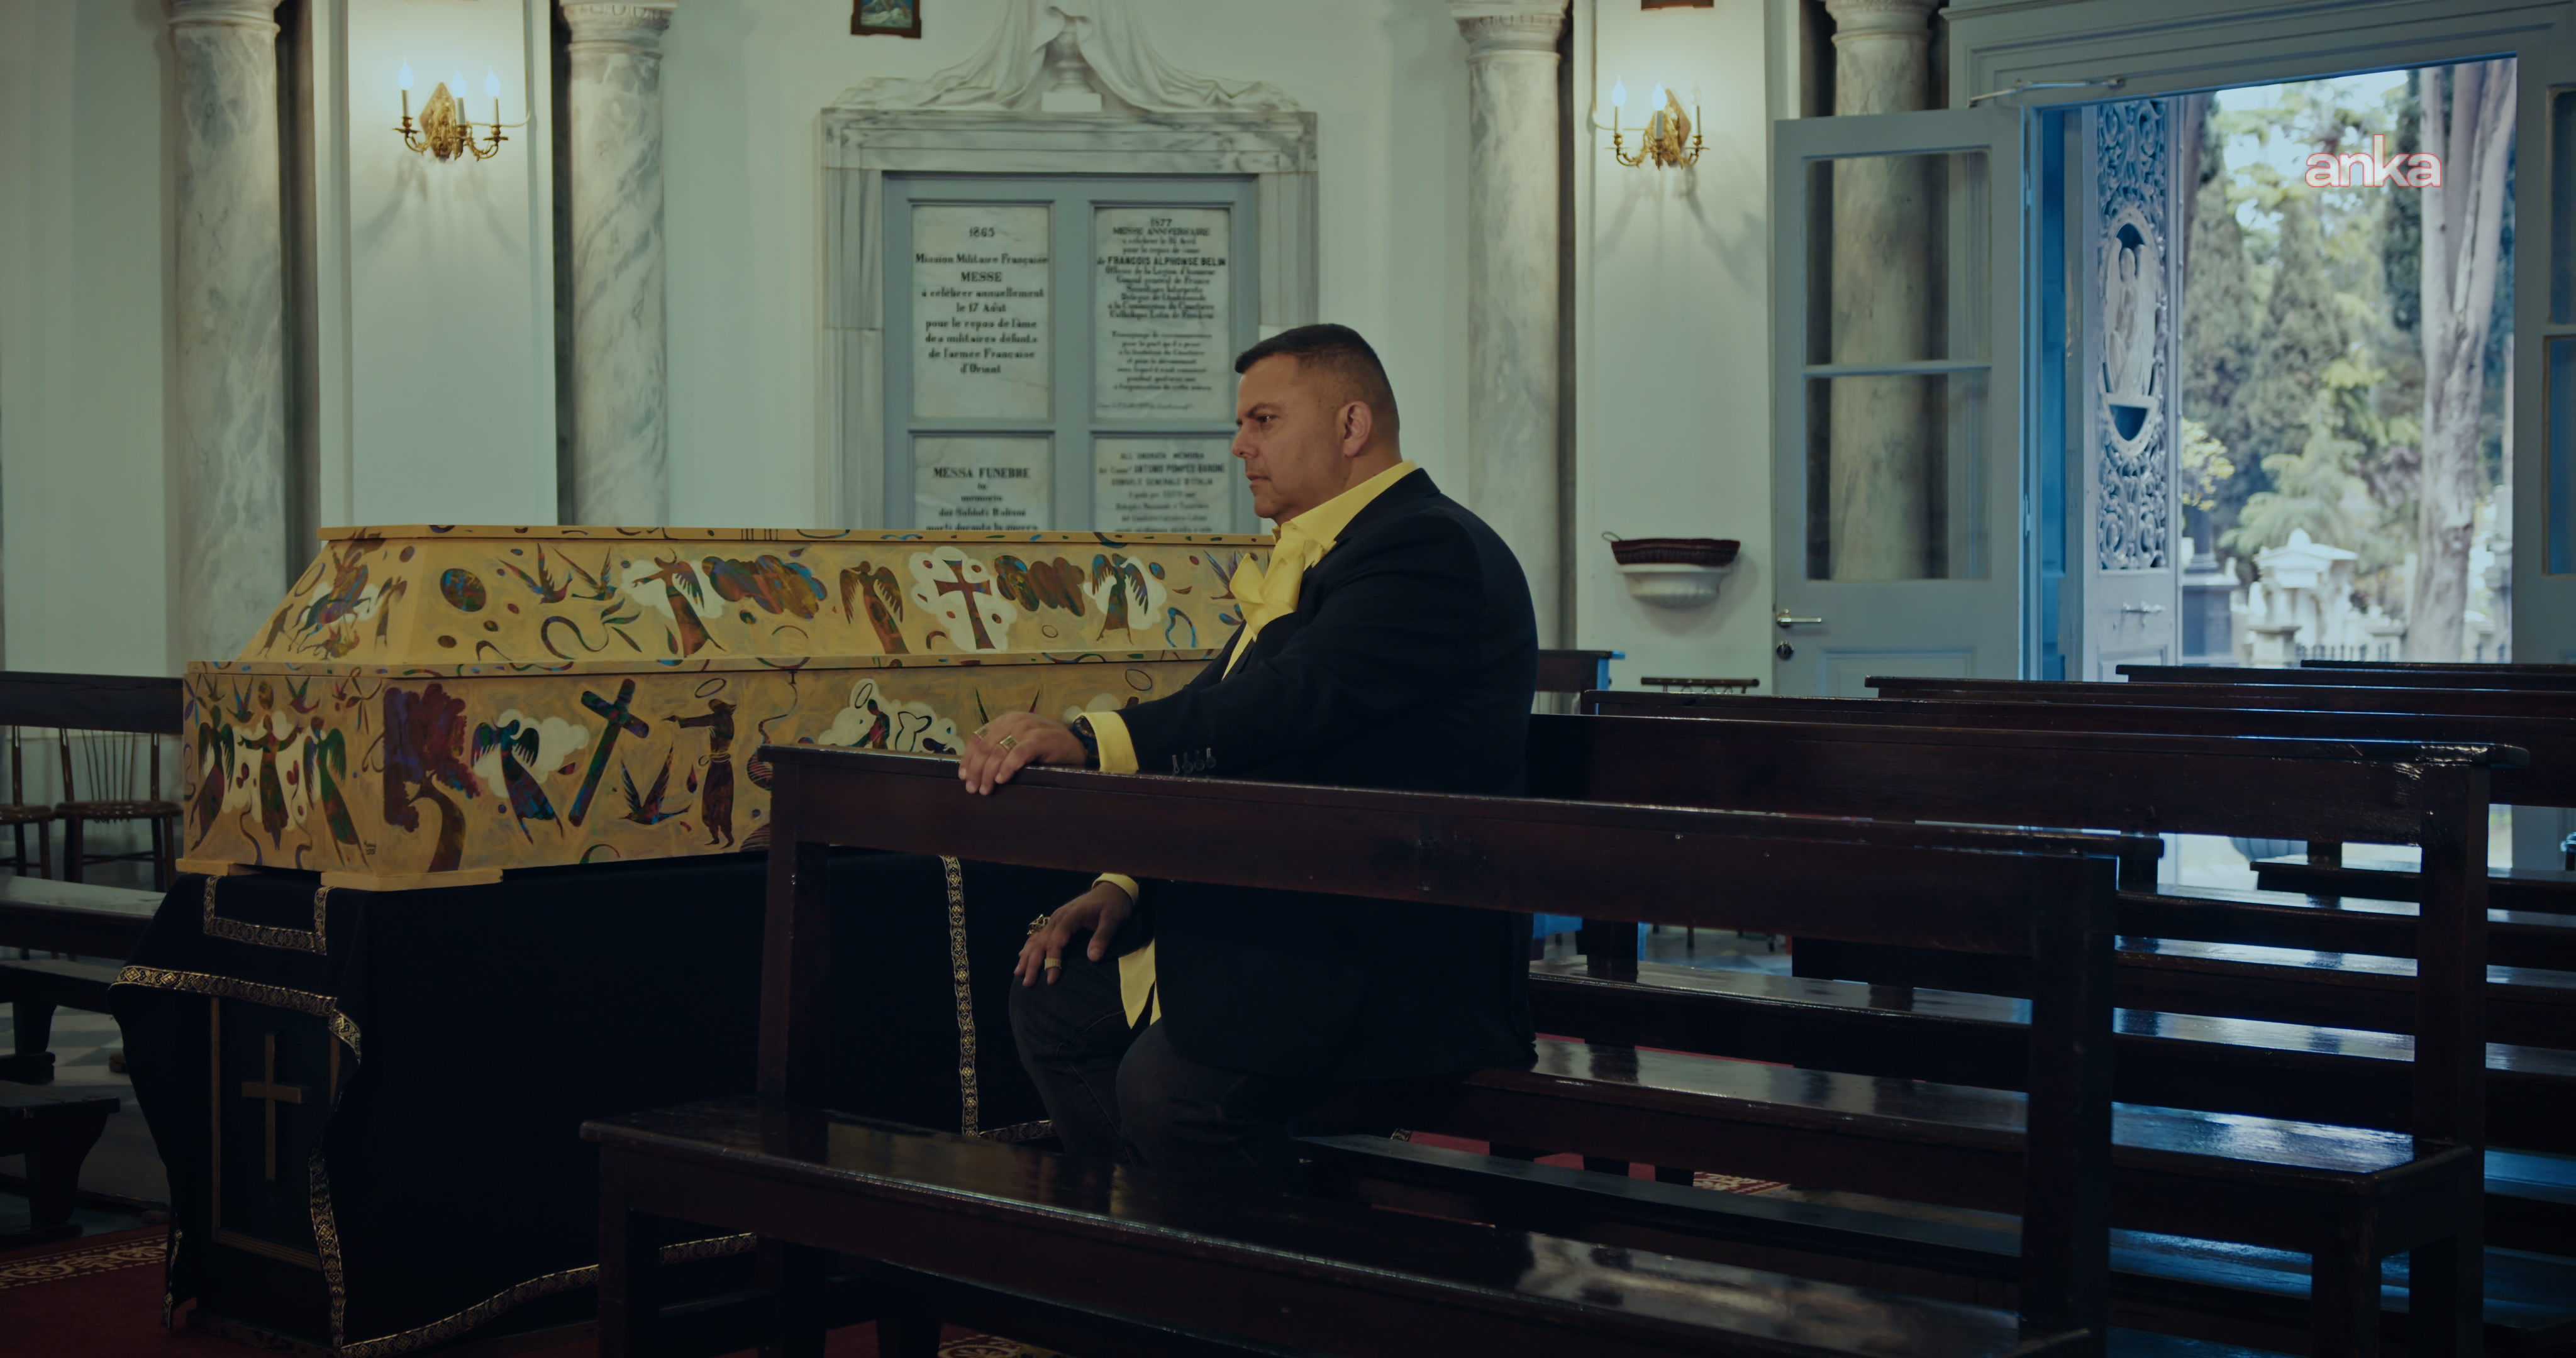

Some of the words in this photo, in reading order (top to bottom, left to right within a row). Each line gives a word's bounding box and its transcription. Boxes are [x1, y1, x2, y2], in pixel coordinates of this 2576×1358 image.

[915, 253, 953, 263] Mission
[955, 253, 998, 263] Militaire
[1153, 256, 1198, 265] ALPHONSE
[960, 271, 1002, 282] MESSE
[975, 287, 1045, 297] annuellement
[956, 302, 966, 312] le
[969, 303, 979, 312] 17
[926, 321, 948, 331] pour
[952, 317, 961, 328] le
[964, 321, 994, 331] repos
[997, 317, 1009, 328] de
[925, 333, 943, 343] des
[947, 333, 996, 343] militaires
[928, 348, 940, 358] de
[933, 467, 974, 478] MESSA
[979, 467, 1031, 478] FUNEBRE
[960, 494, 1002, 502] memoria
